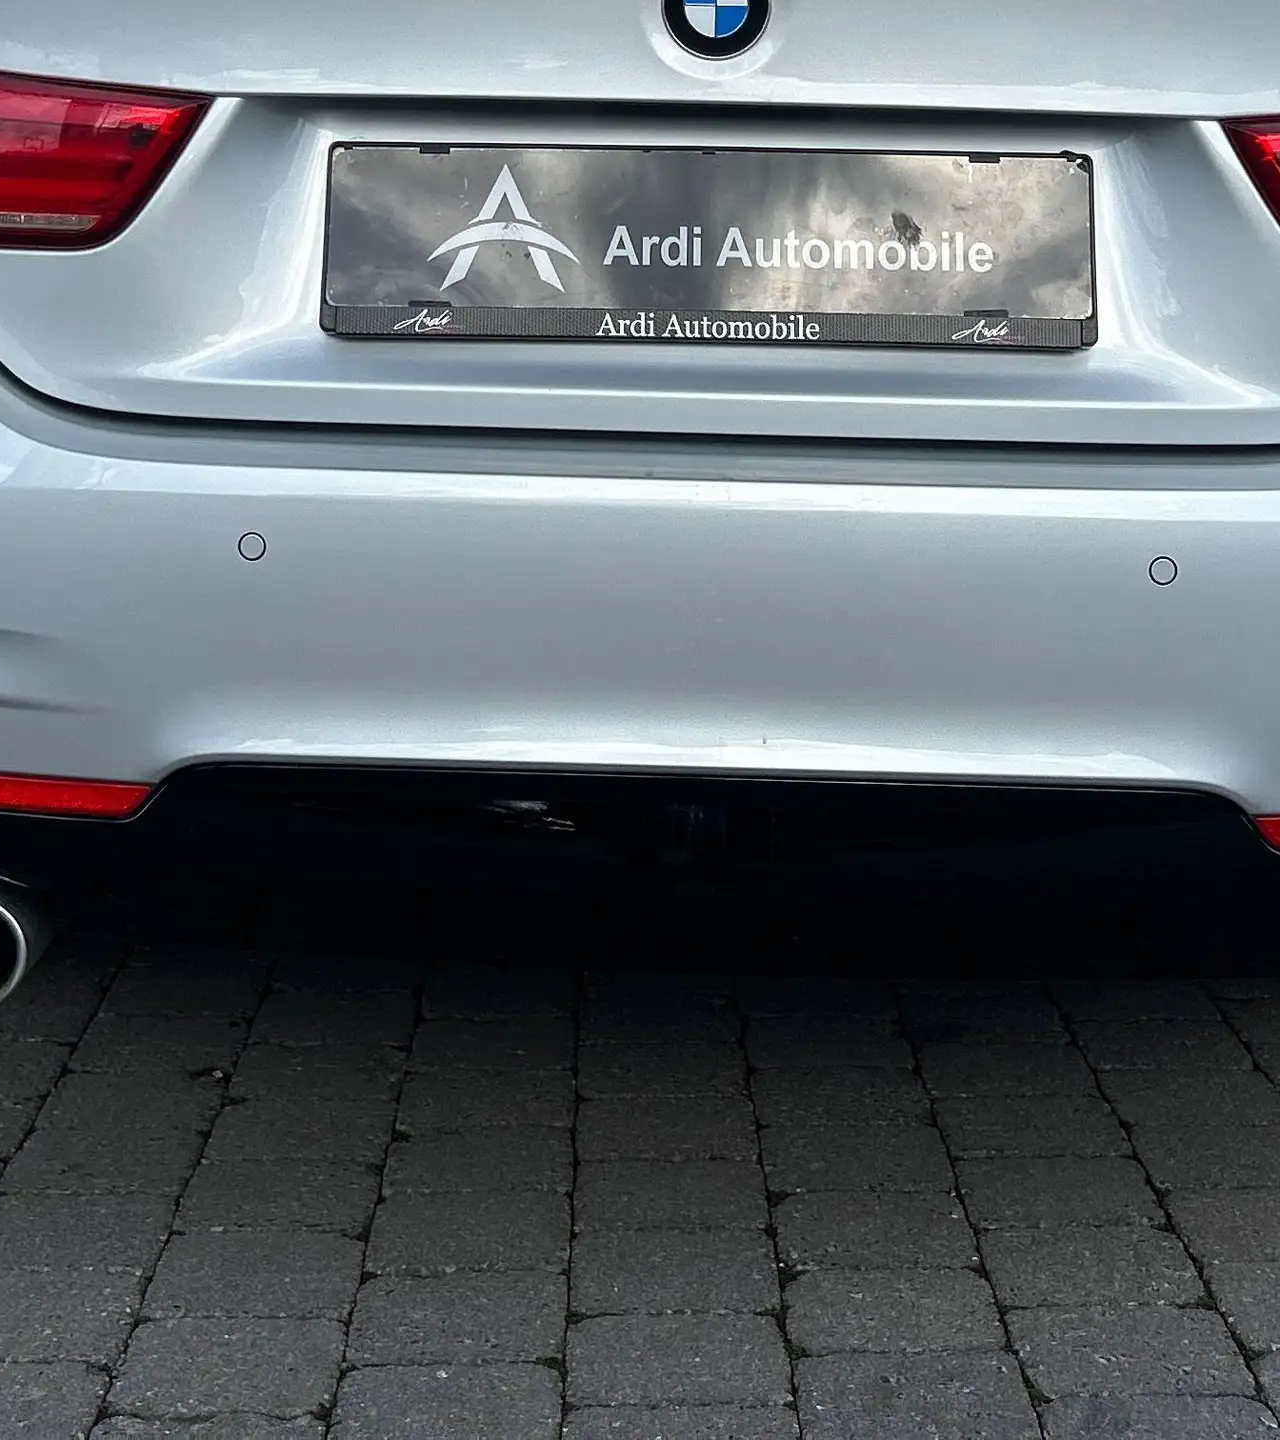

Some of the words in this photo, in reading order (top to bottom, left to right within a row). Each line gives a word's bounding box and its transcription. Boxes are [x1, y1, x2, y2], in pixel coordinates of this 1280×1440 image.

[602, 225, 703, 267] Ardi
[715, 226, 994, 273] Automobile
[393, 308, 453, 333] Ardi
[596, 312, 656, 338] Ardi
[662, 313, 821, 341] Automobile
[951, 319, 1010, 343] Ardi
